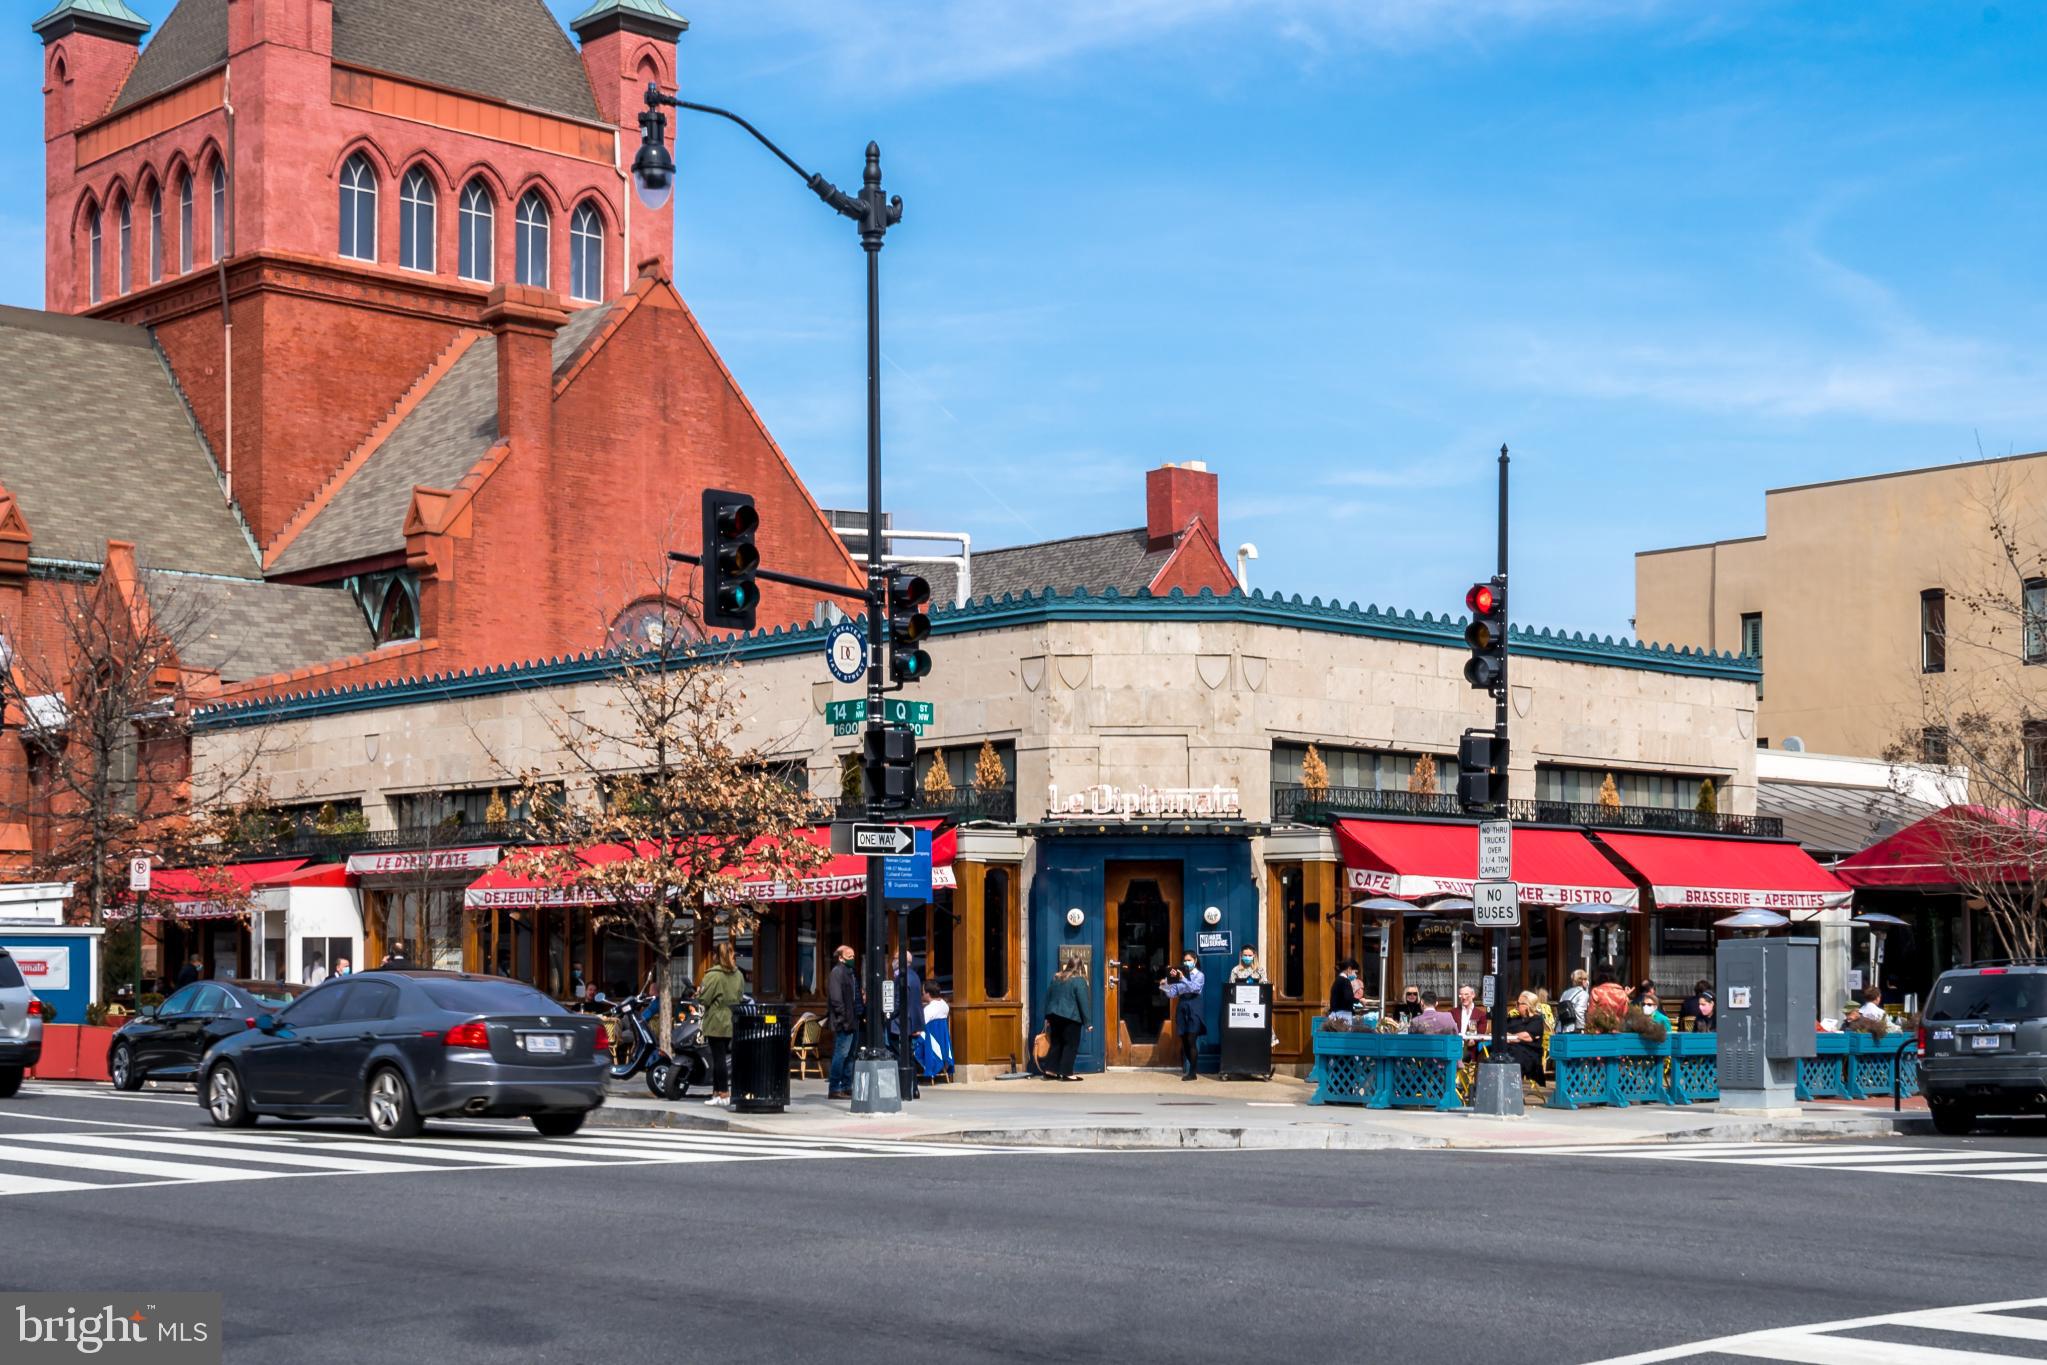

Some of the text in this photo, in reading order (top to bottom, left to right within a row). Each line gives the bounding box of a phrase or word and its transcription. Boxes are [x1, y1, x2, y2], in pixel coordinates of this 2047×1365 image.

[832, 625, 862, 640] GREATER
[829, 659, 865, 681] 14TH STREET
[833, 701, 864, 720] 14 ST
[855, 710, 864, 719] NW
[896, 702, 928, 720] Q ST
[918, 713, 930, 721] NW
[834, 722, 858, 735] 1600
[1048, 783, 1239, 822] Le Diplomate
[1492, 826, 1508, 834] THRU
[860, 834, 896, 845] ONE WAY
[1484, 836, 1506, 844] TRUCKS
[376, 853, 469, 869] LE DIPLOMATE
[1481, 866, 1508, 874] CAPACITY
[1355, 872, 1392, 890] CAFE
[1434, 880, 1474, 895] FRUIT
[1560, 888, 1612, 904] BISTRO
[1487, 889, 1502, 901] NO
[1686, 890, 1750, 905] BRASSERIE
[1764, 893, 1825, 906] APERITIFS
[1477, 906, 1514, 920] BUSES
[1424, 925, 1477, 946] DIPLOTE
